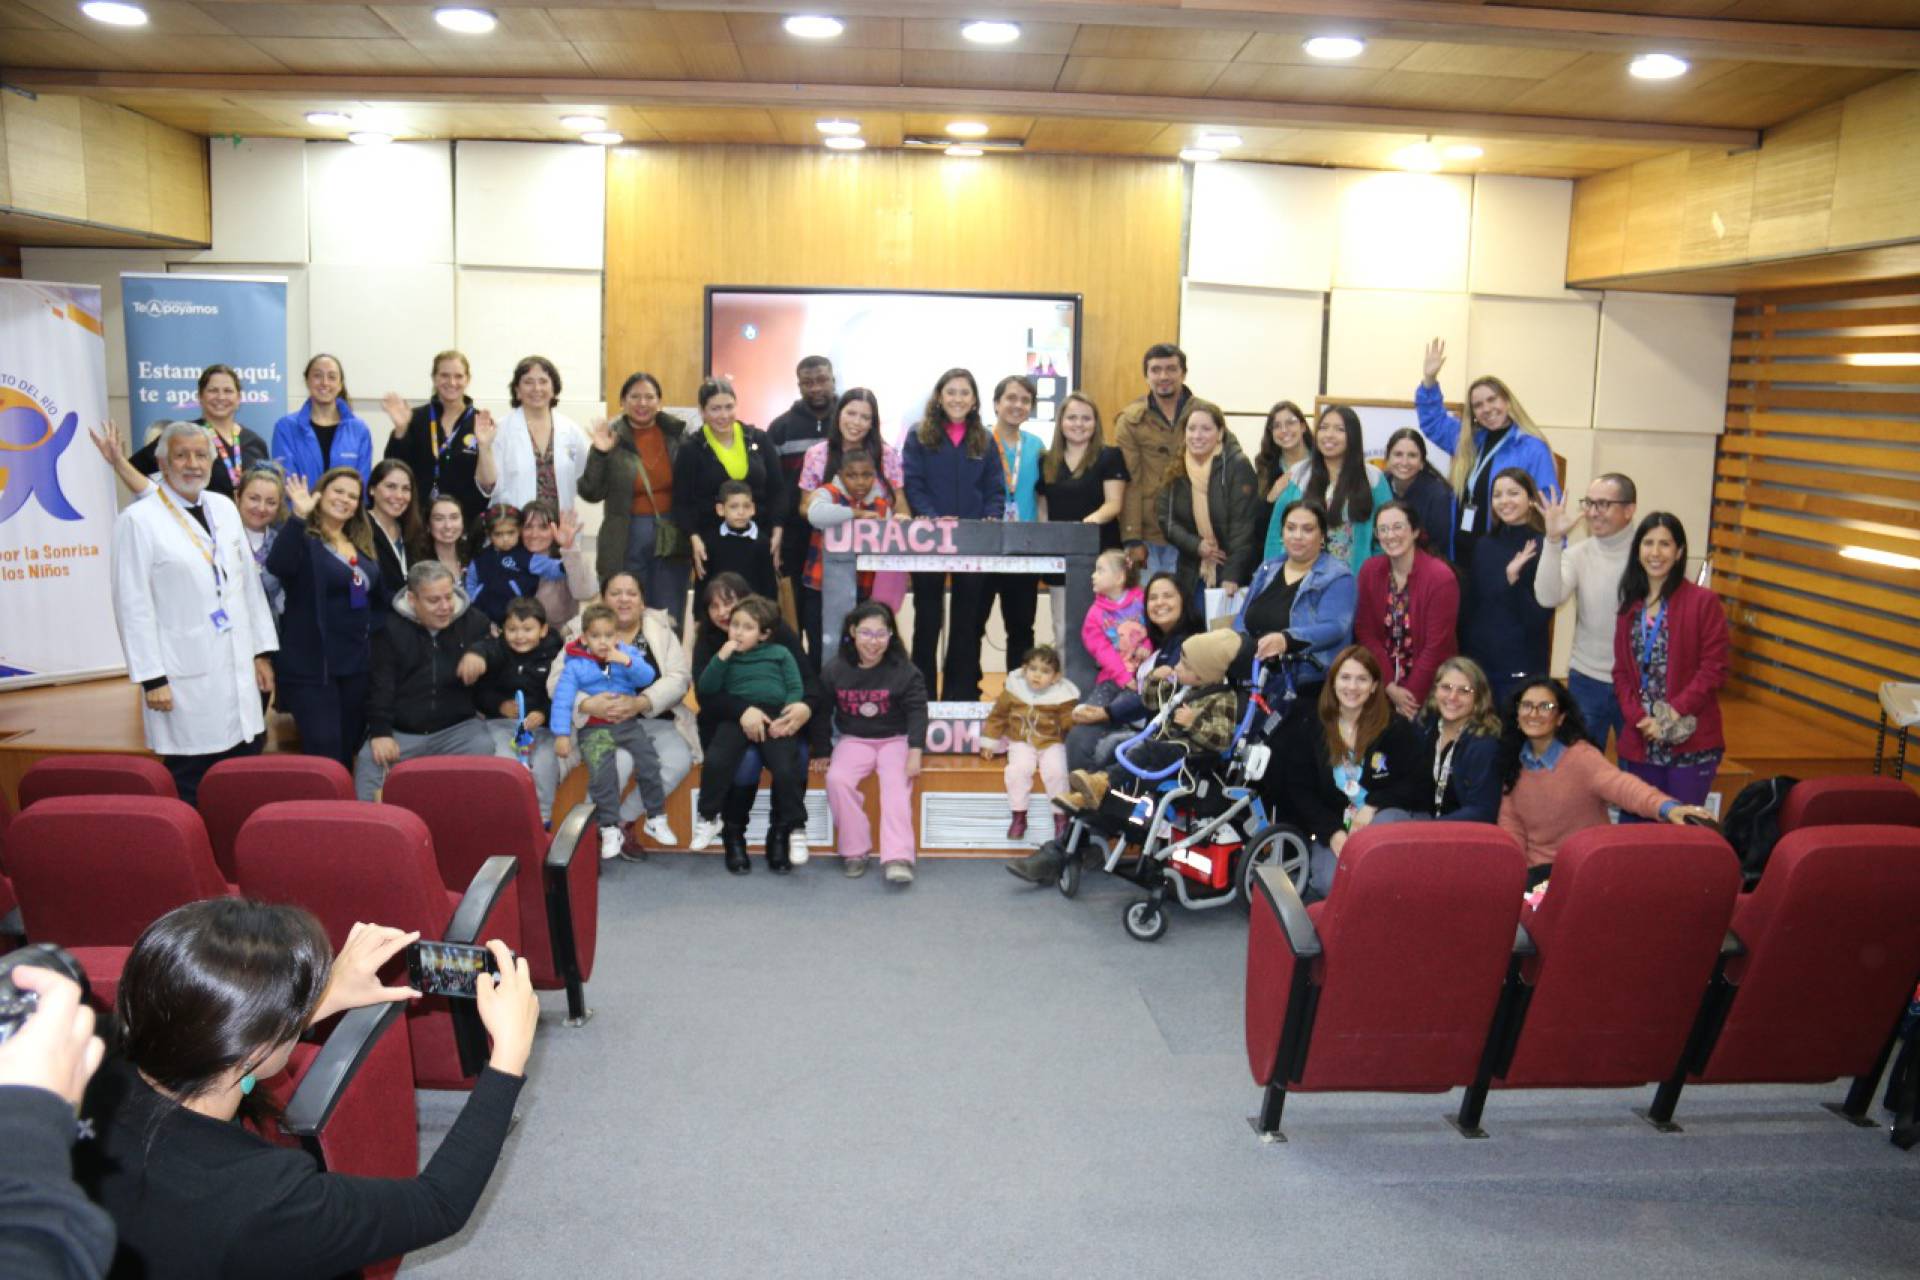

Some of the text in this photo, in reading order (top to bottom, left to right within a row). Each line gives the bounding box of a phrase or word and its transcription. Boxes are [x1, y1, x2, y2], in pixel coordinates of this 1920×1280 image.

[138, 361, 201, 379] Estam
[1, 373, 16, 385] TO
[18, 380, 39, 398] DEL
[139, 387, 159, 402] te
[0, 543, 98, 561] or la Sonrisa
[2, 564, 70, 581] los Niños
